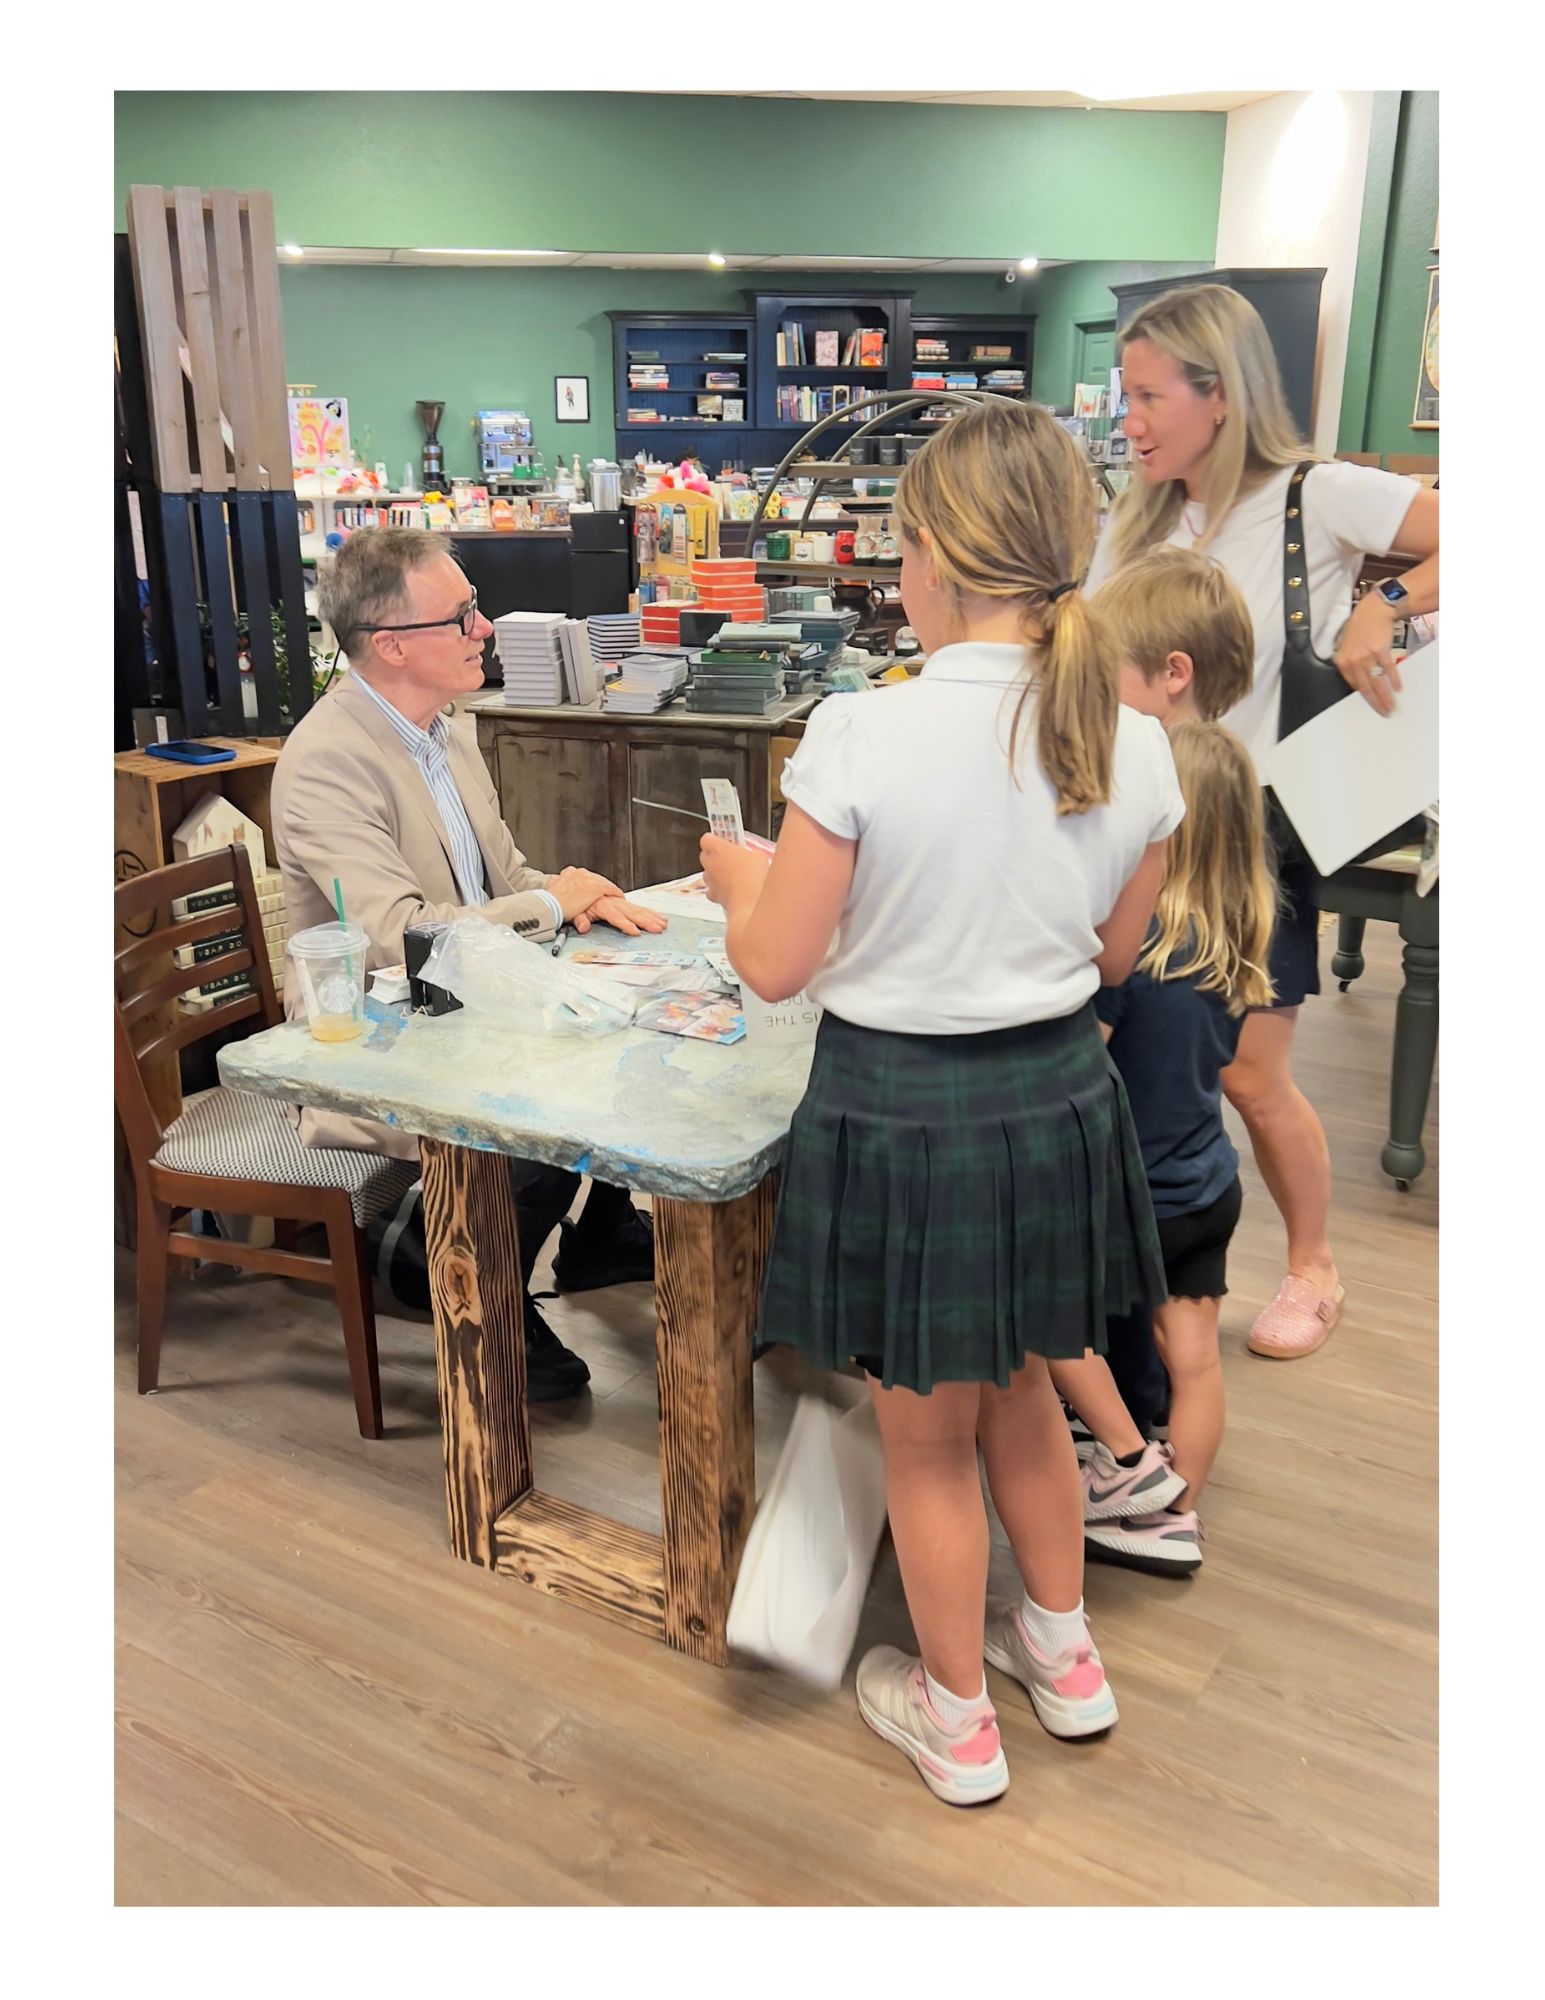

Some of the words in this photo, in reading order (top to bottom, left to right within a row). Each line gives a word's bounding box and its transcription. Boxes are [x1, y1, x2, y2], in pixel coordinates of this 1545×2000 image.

[191, 896, 217, 907] YEAR
[198, 945, 224, 957] YEAR
[204, 978, 229, 990] YEAR
[764, 1014, 797, 1027] THE
